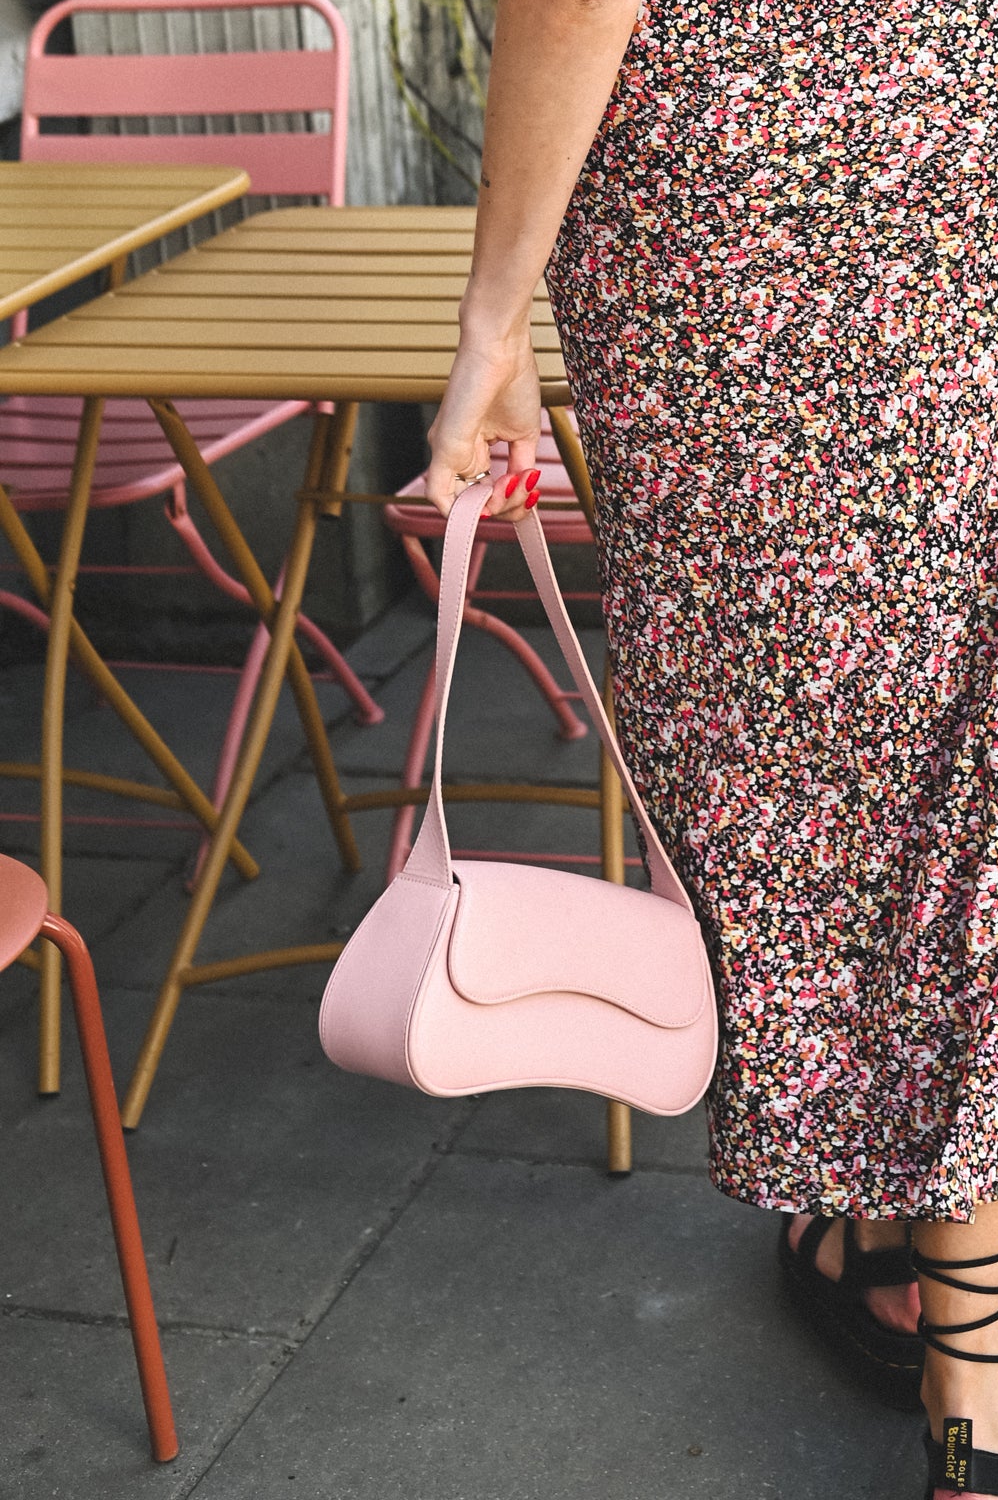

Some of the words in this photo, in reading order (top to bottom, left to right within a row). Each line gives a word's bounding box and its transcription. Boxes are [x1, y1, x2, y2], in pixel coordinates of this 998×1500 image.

[960, 1421, 968, 1445] WITH
[945, 1426, 959, 1479] Bouncing
[957, 1459, 967, 1488] SOLES
